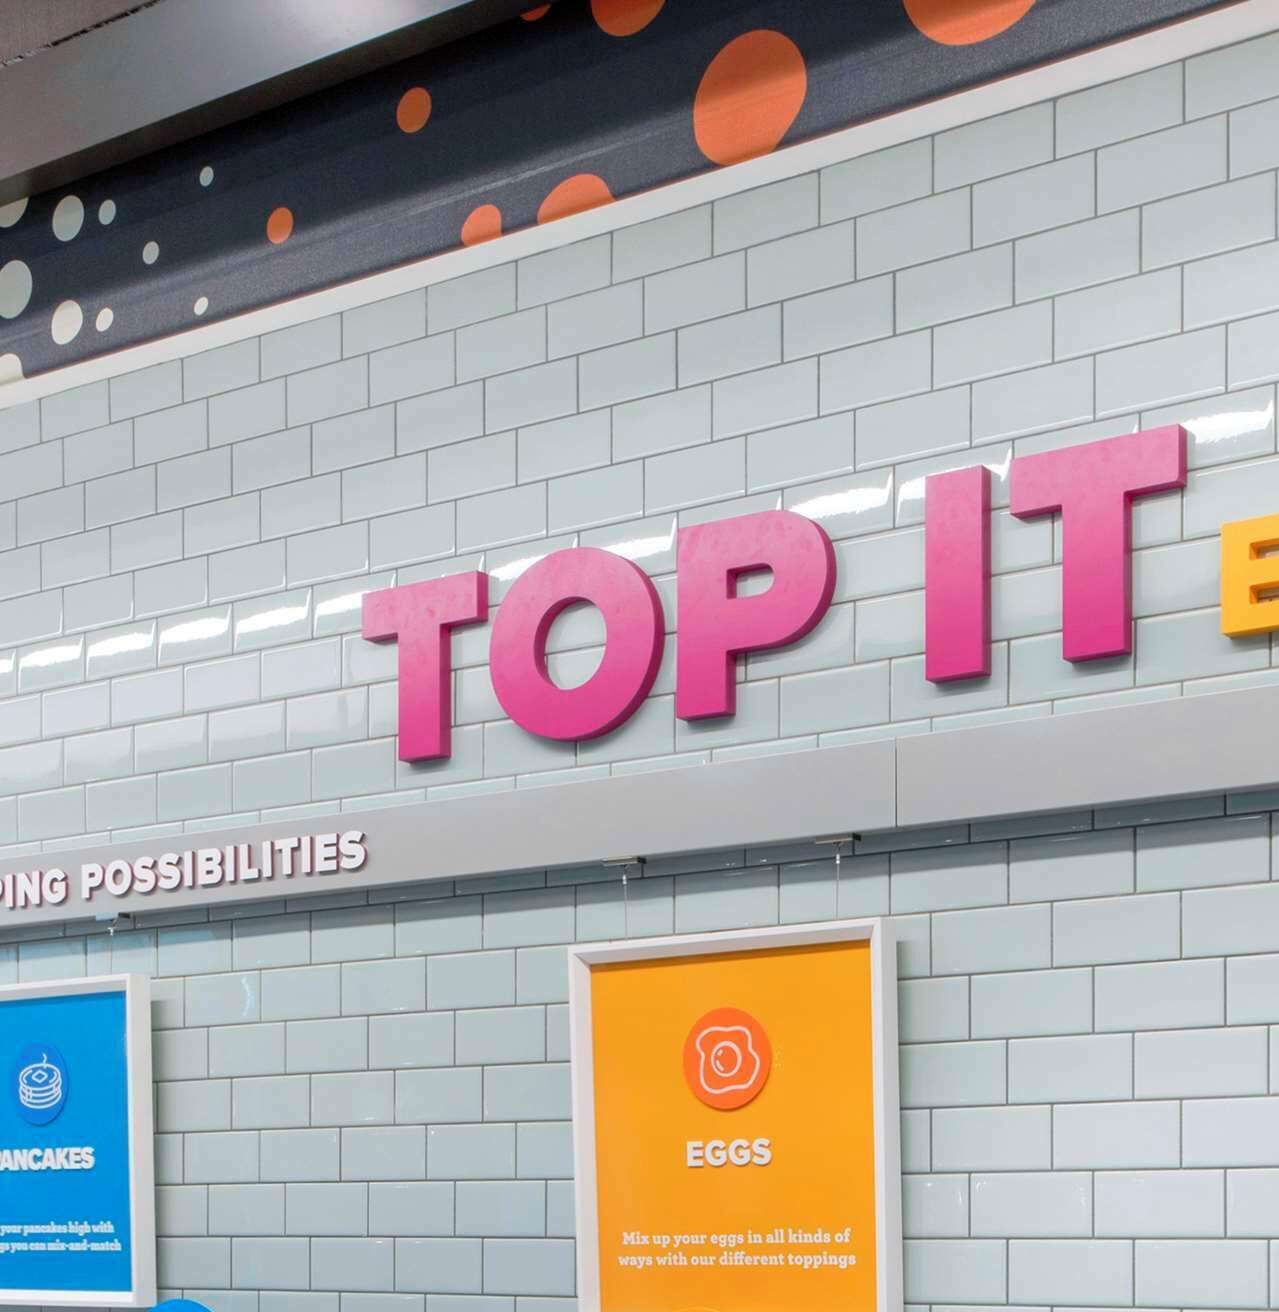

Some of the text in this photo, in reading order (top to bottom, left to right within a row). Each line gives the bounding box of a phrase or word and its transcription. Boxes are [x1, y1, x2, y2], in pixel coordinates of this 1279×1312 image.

[362, 514, 836, 762] TOP
[924, 424, 1188, 684] IT
[81, 830, 367, 901] POSSIBILITIES
[686, 1138, 772, 1168] EGGS
[0, 1224, 22, 1236] your
[23, 1221, 67, 1236] pancakes
[68, 1221, 91, 1236] high
[91, 1220, 115, 1233] with
[622, 1227, 852, 1248] Mix up your eggs in all kinds of
[10, 1242, 28, 1253] you
[29, 1242, 46, 1251] can
[47, 1239, 122, 1251] mix-and-match
[618, 1251, 857, 1269] ways with our different toppings
